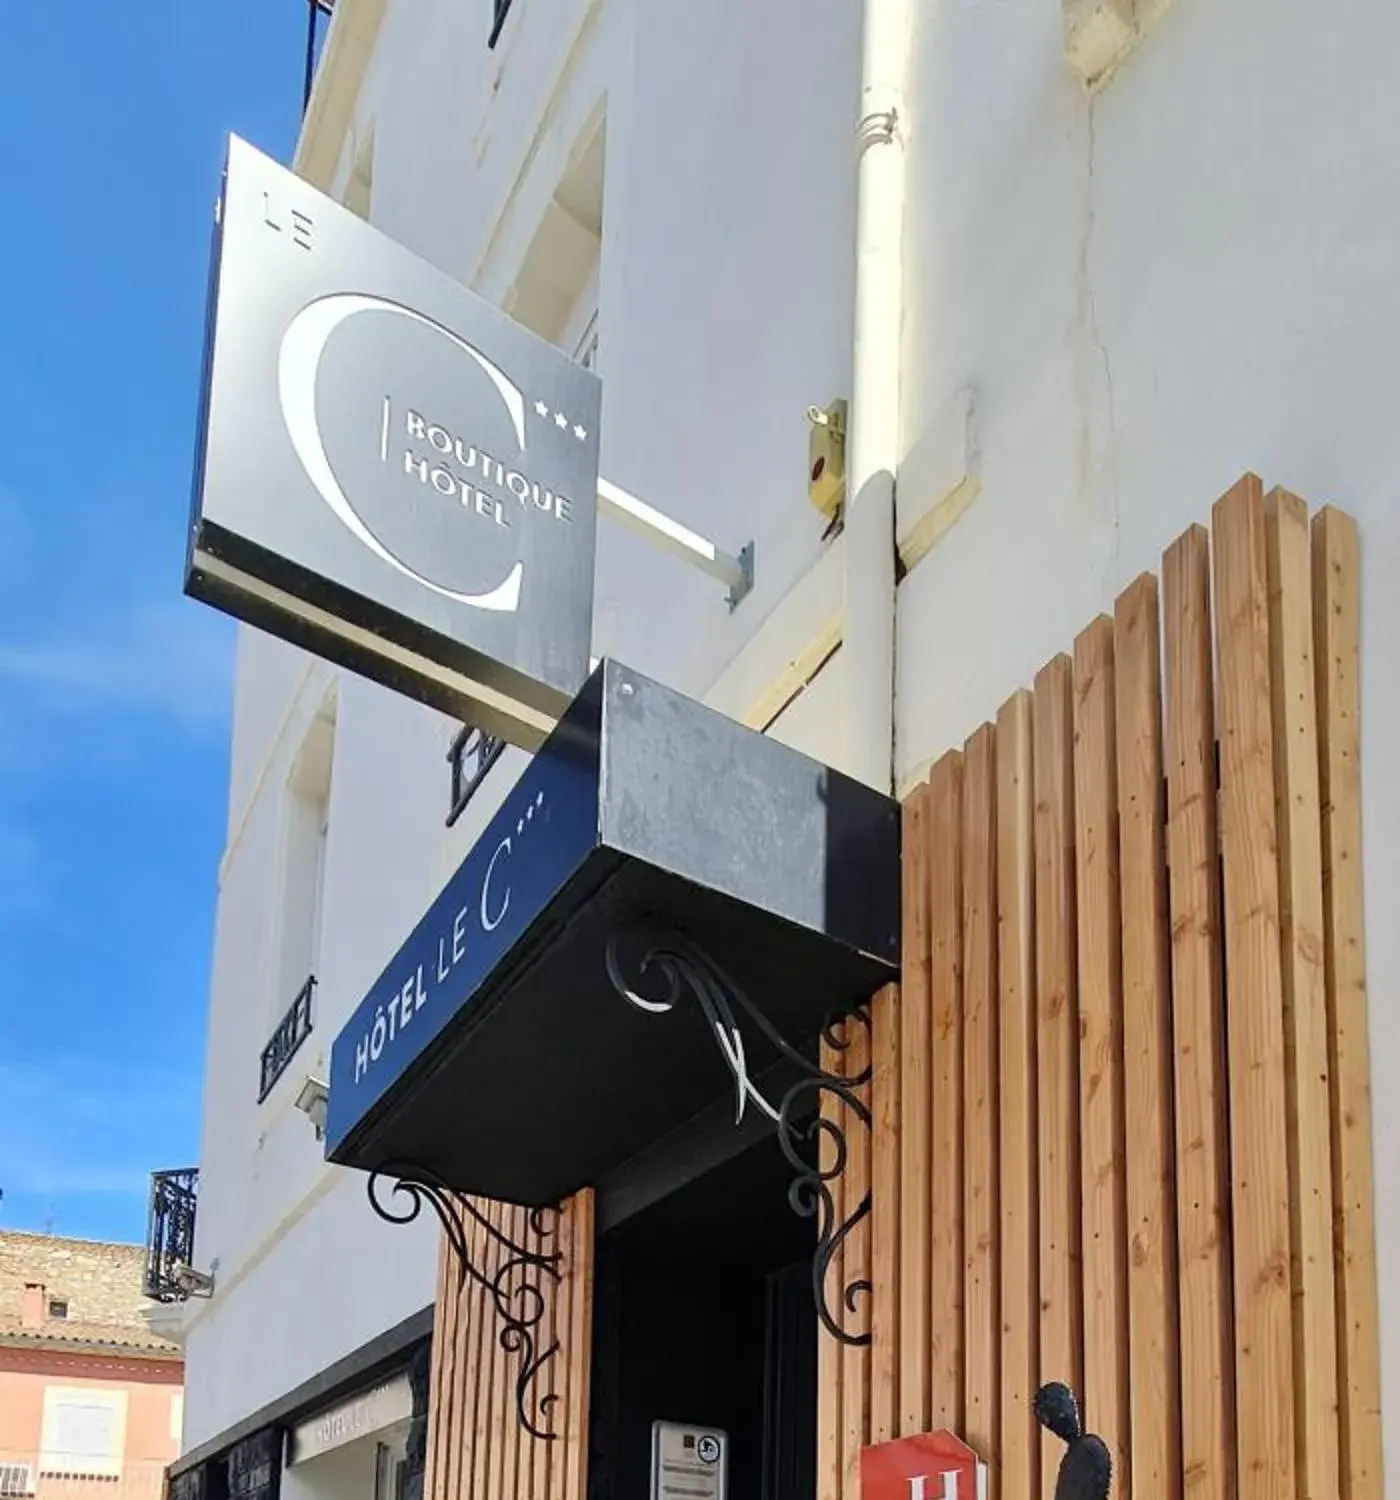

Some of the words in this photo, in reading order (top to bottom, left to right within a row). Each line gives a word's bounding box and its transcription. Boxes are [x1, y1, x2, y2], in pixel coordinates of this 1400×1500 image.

[262, 191, 314, 251] LE
[278, 291, 526, 611] C
[404, 448, 512, 527] HÔTEL
[406, 409, 574, 525] BOUTIQUE
[355, 964, 427, 1084] HÔTEL
[437, 906, 468, 984] LE
[481, 836, 511, 931] C
